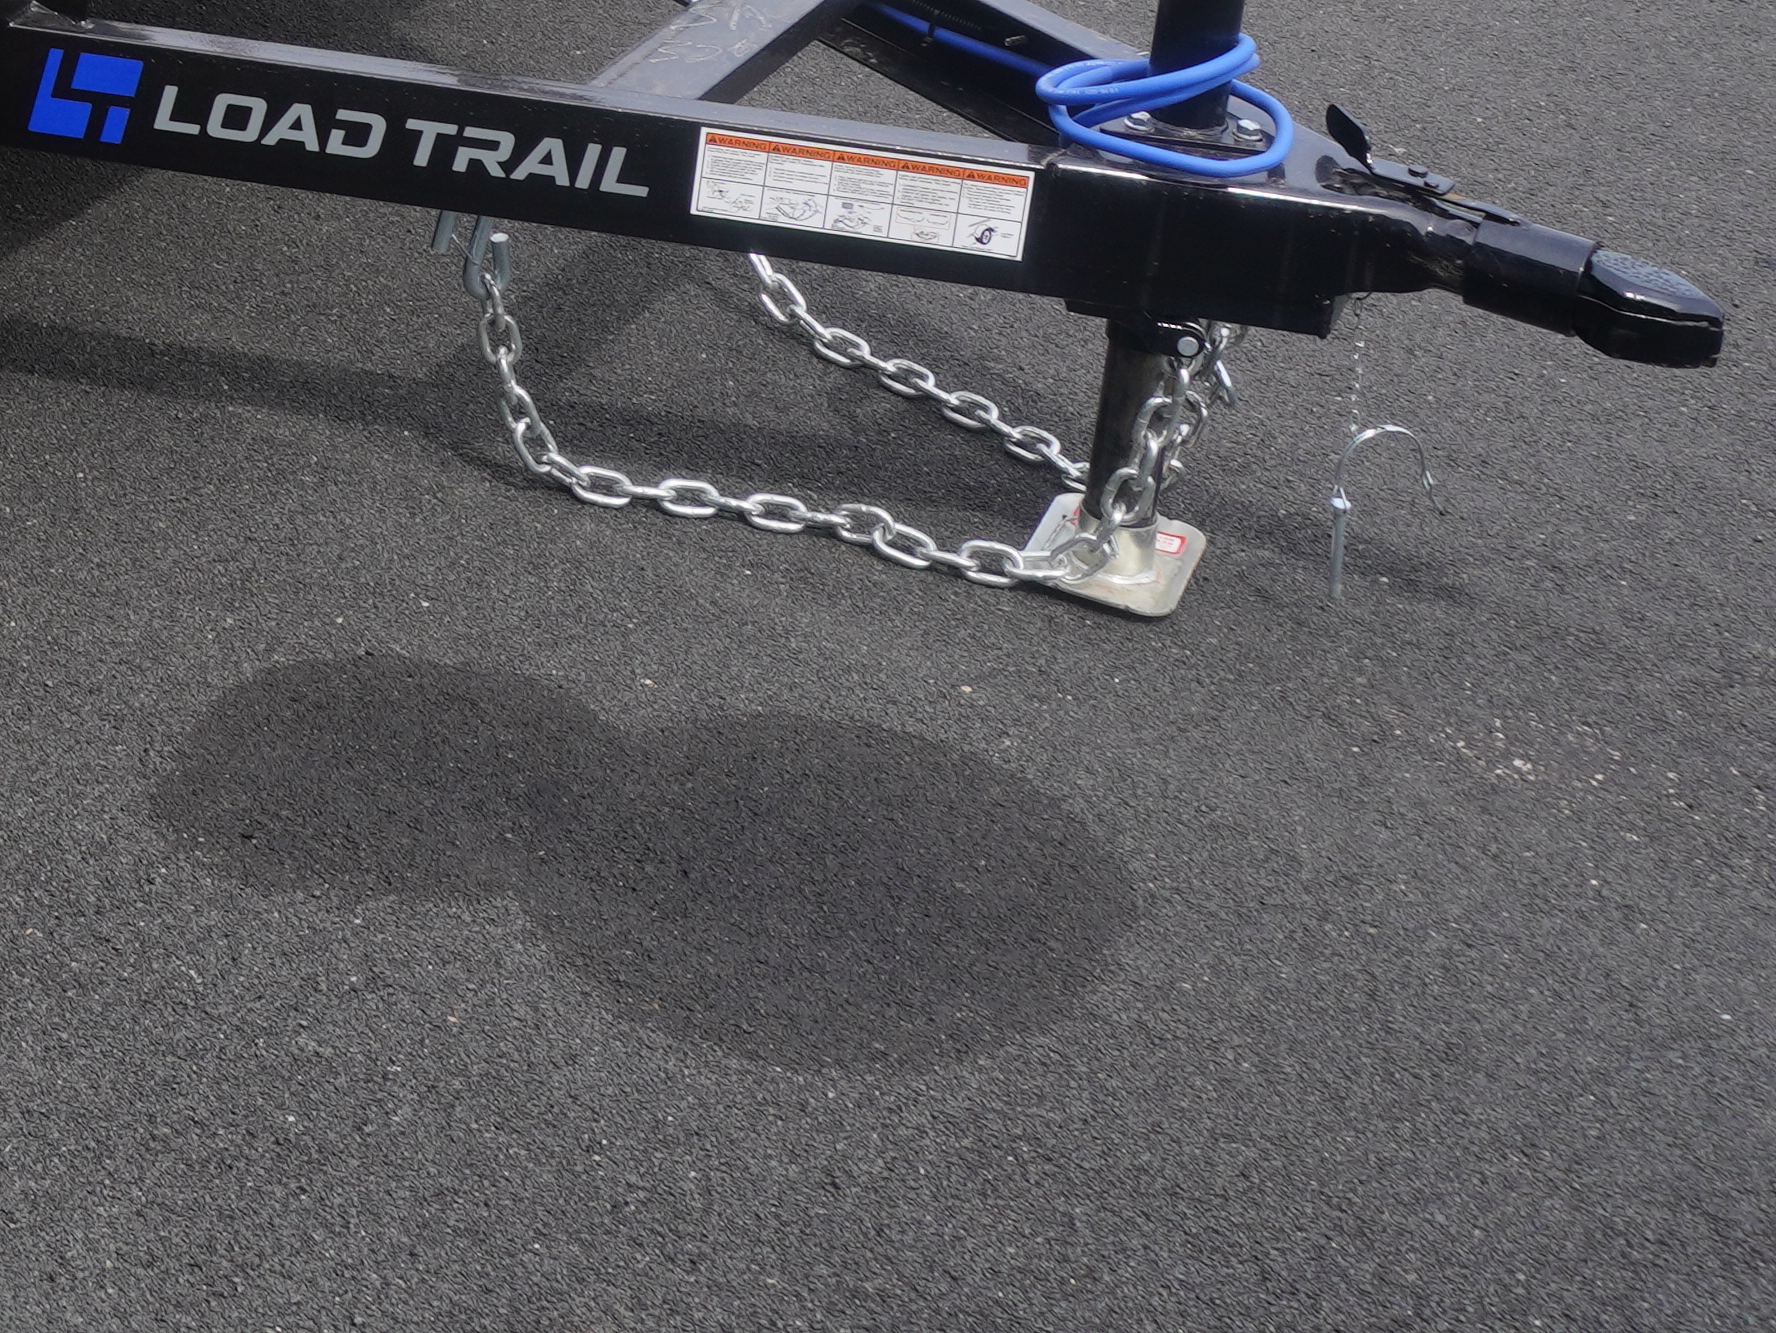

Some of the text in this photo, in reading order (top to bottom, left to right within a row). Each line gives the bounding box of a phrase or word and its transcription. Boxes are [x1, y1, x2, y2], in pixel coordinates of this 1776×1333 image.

[154, 85, 386, 159] LOAD
[405, 119, 649, 197] TRAIL
[718, 137, 767, 151] WARNING
[780, 147, 831, 160] WARNING
[847, 153, 896, 168] WARNING
[911, 165, 961, 178] WARNING
[977, 174, 1027, 187] WARNING
